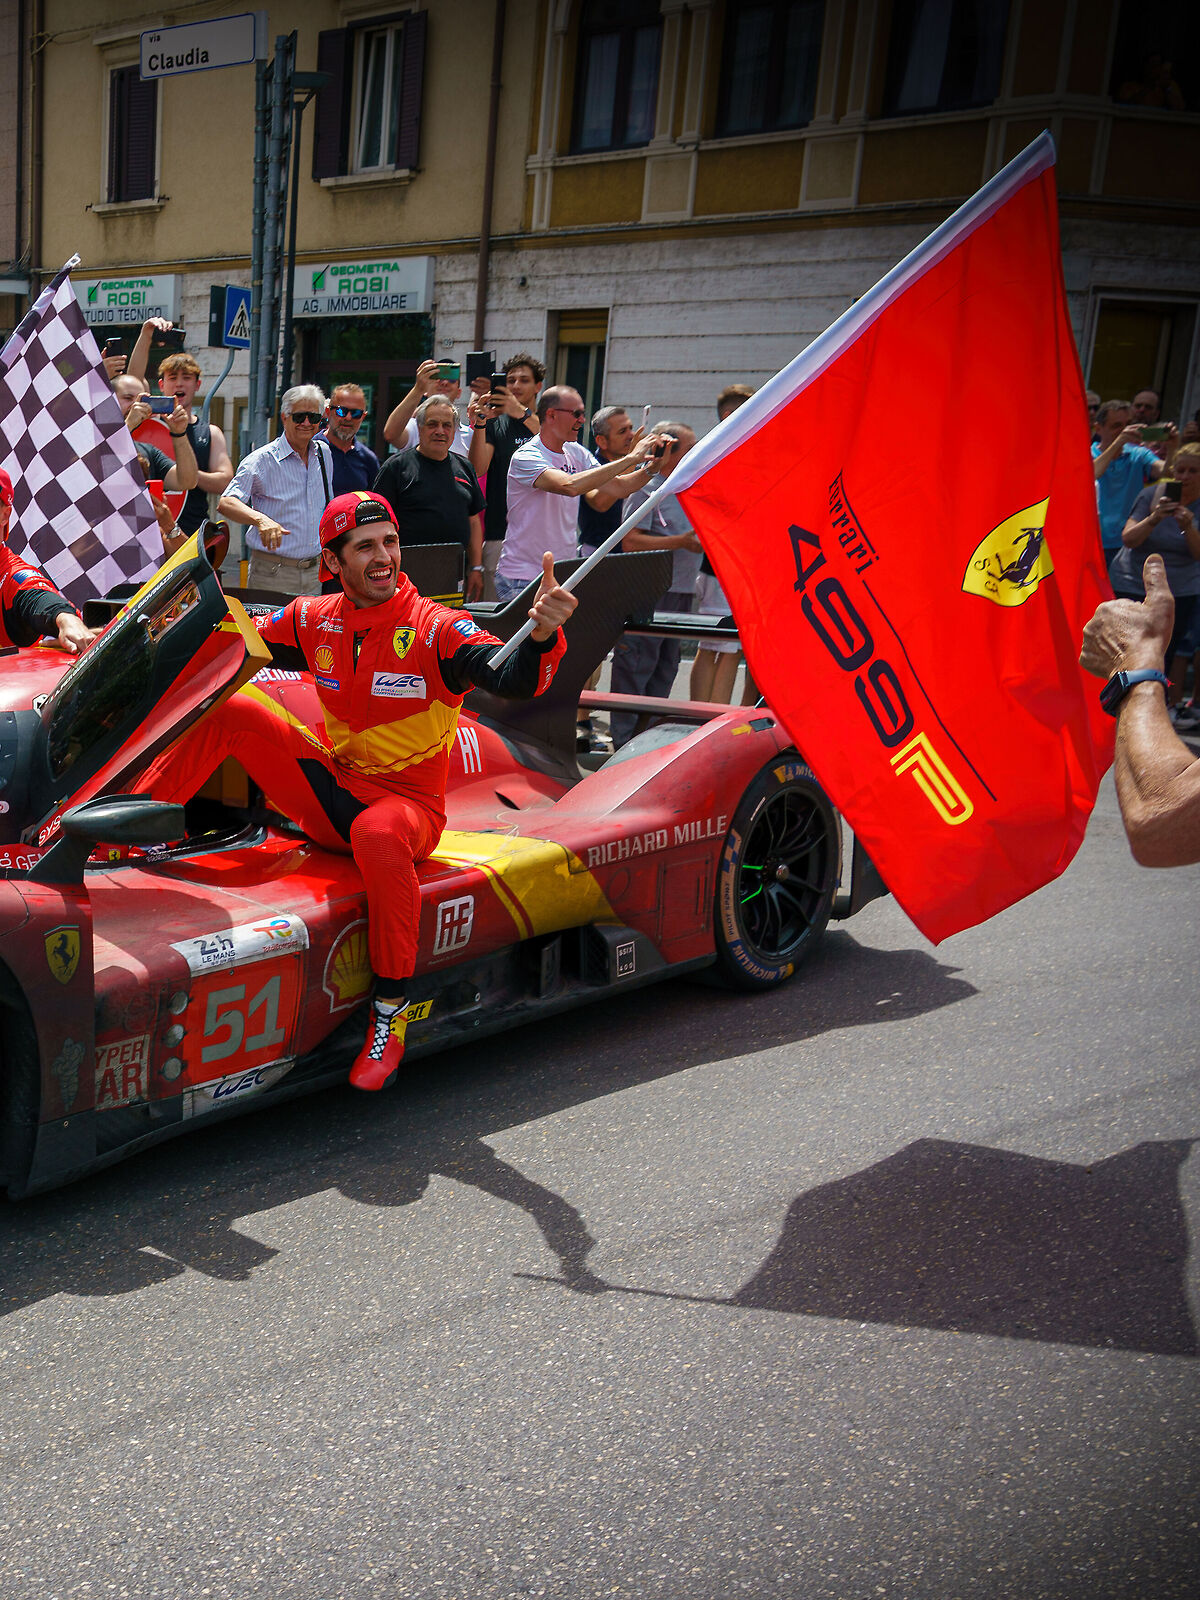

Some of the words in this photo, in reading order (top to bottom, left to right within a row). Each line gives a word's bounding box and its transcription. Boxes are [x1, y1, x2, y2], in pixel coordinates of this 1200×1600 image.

[149, 33, 161, 43] via
[148, 47, 210, 71] Claudia
[330, 262, 400, 276] GEOMETRA
[101, 280, 154, 291] GEOMETRA
[338, 276, 389, 294] ROSI
[107, 291, 146, 306] ROSI
[302, 299, 322, 313] AG.
[327, 294, 408, 312] IMMOBILIARE
[83, 309, 114, 323] TUDIO
[117, 307, 163, 321] TECNICO
[828, 468, 880, 576] Ferrari
[375, 675, 424, 688] WEC
[788, 523, 974, 825] 499P
[38, 815, 62, 844] SYS
[587, 829, 668, 868] RICHARD
[673, 815, 728, 847] MILLE
[16, 854, 42, 870] GE
[193, 934, 234, 956] 24h
[202, 955, 212, 963] LE
[213, 950, 236, 960] MANS
[732, 944, 778, 980] MICHELIN
[201, 975, 286, 1064] 51
[406, 1001, 427, 1021] elt
[95, 1039, 144, 1069] YPER
[97, 1062, 144, 1104] AR
[213, 1064, 270, 1099] WEC
